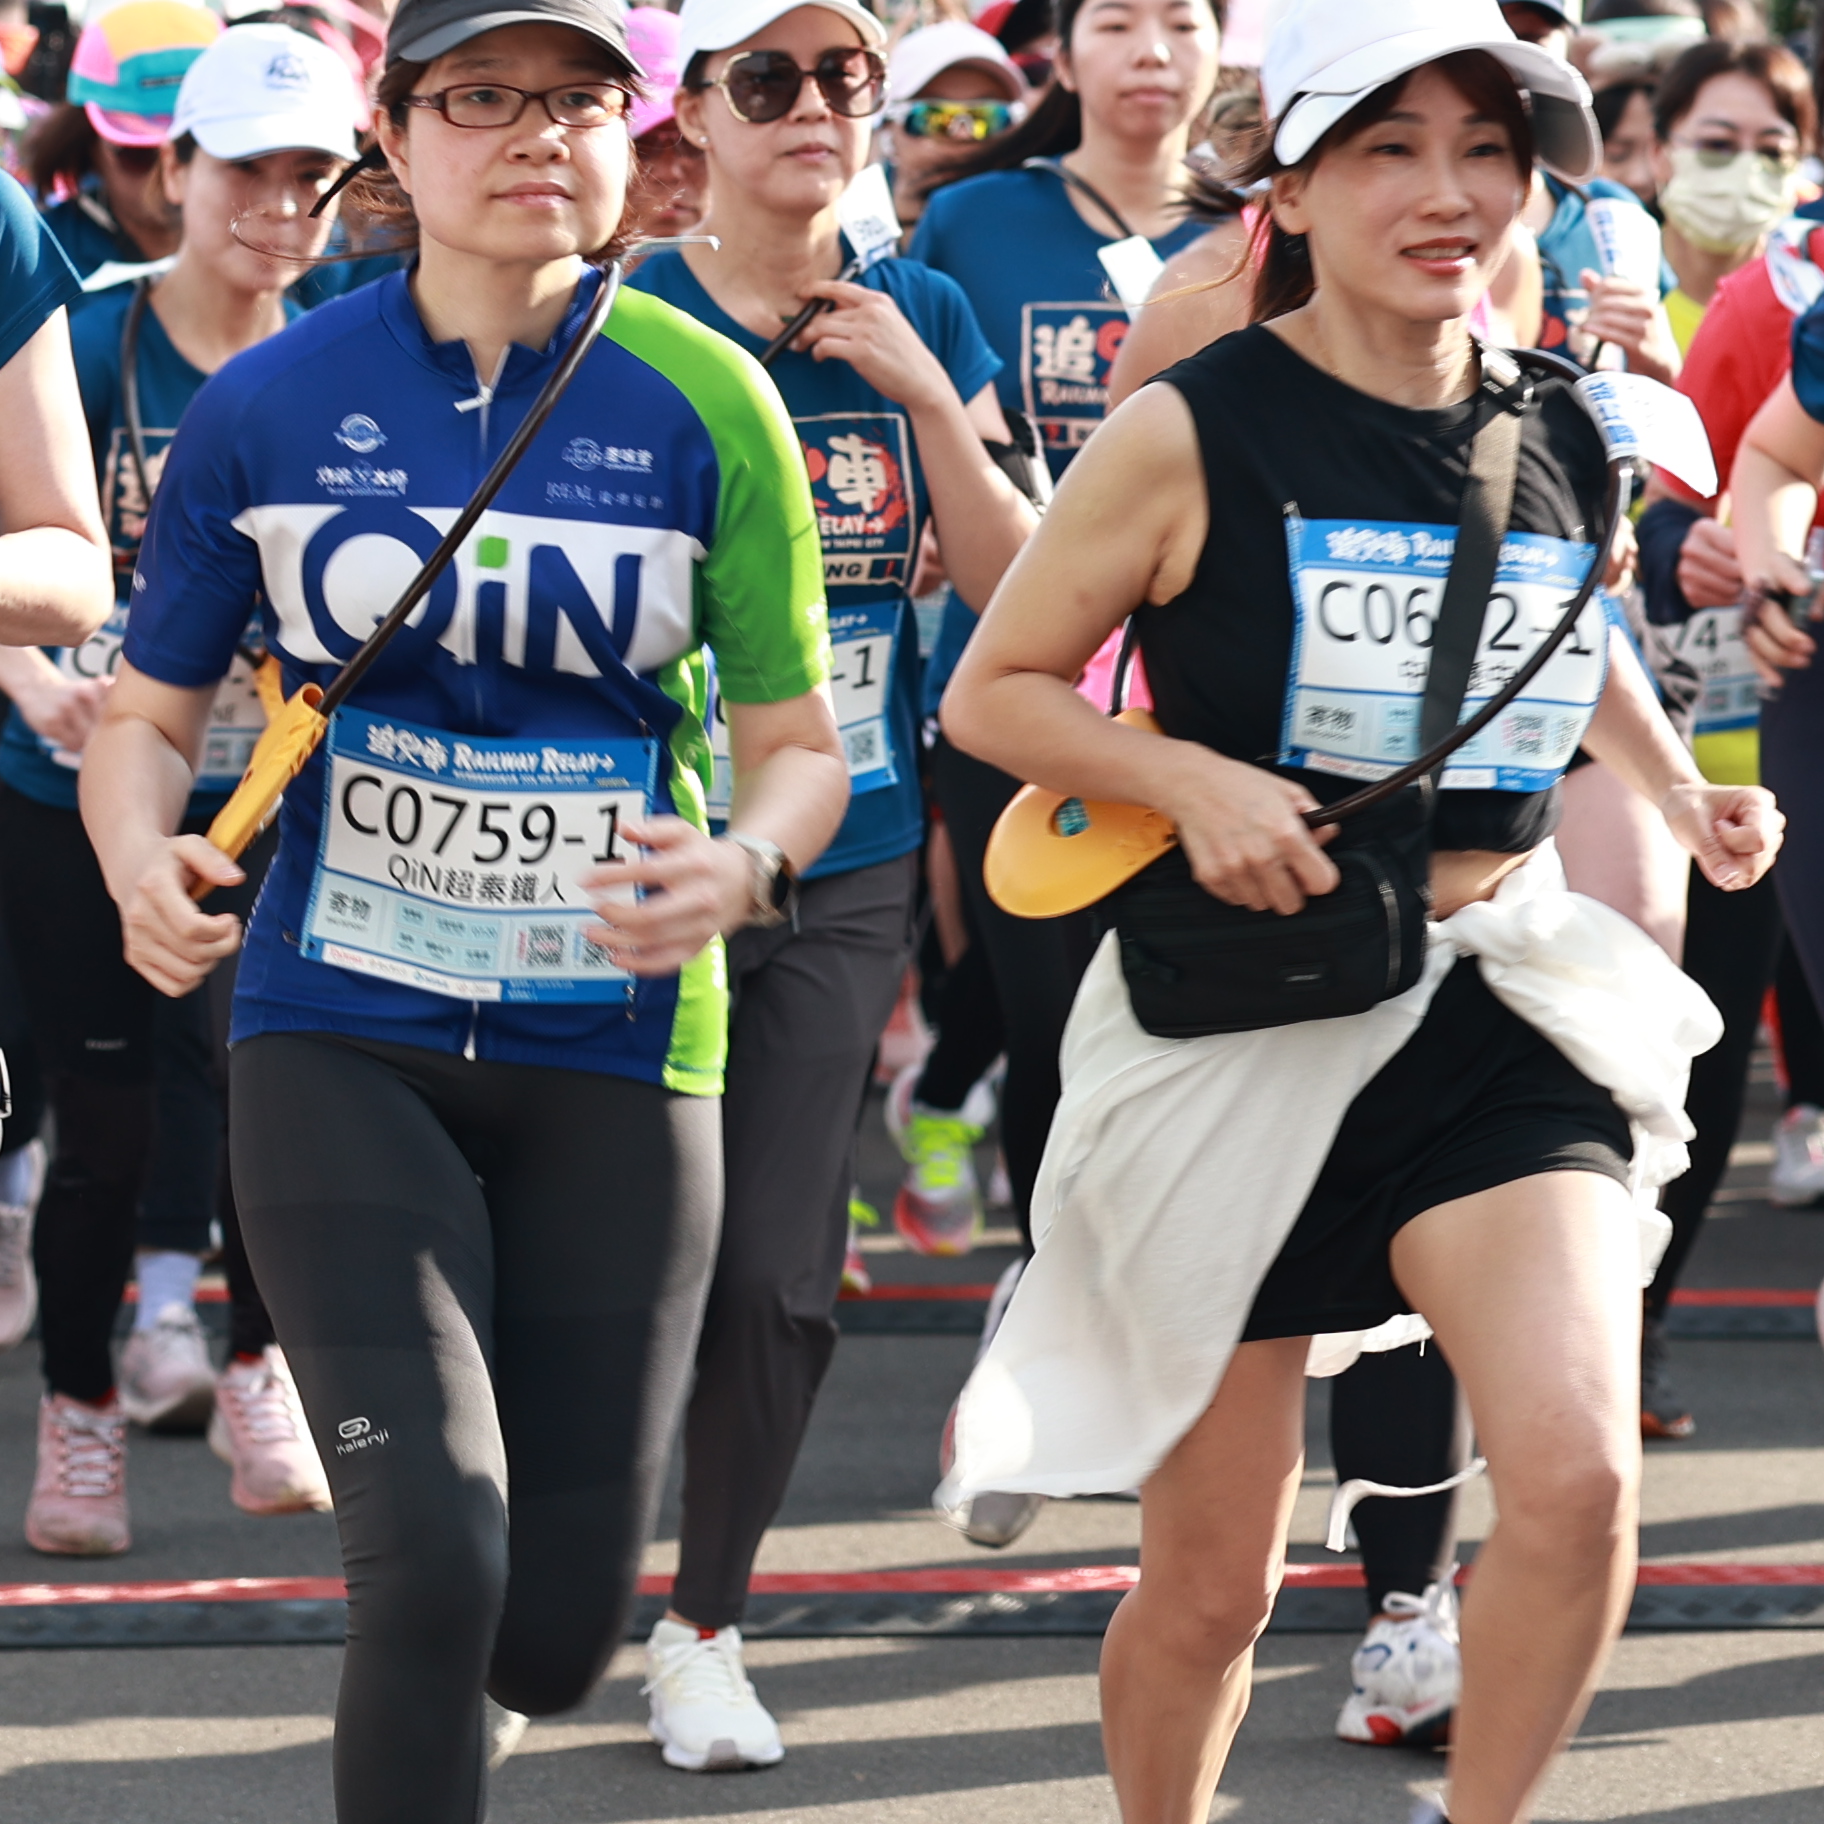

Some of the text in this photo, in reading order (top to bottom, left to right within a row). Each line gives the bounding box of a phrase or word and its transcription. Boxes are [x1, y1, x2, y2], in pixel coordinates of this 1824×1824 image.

[820, 516, 867, 535] ELAY
[1317, 580, 1594, 657] C062-1
[341, 773, 627, 866] C0759-1
[335, 1428, 390, 1457] Kalenji
